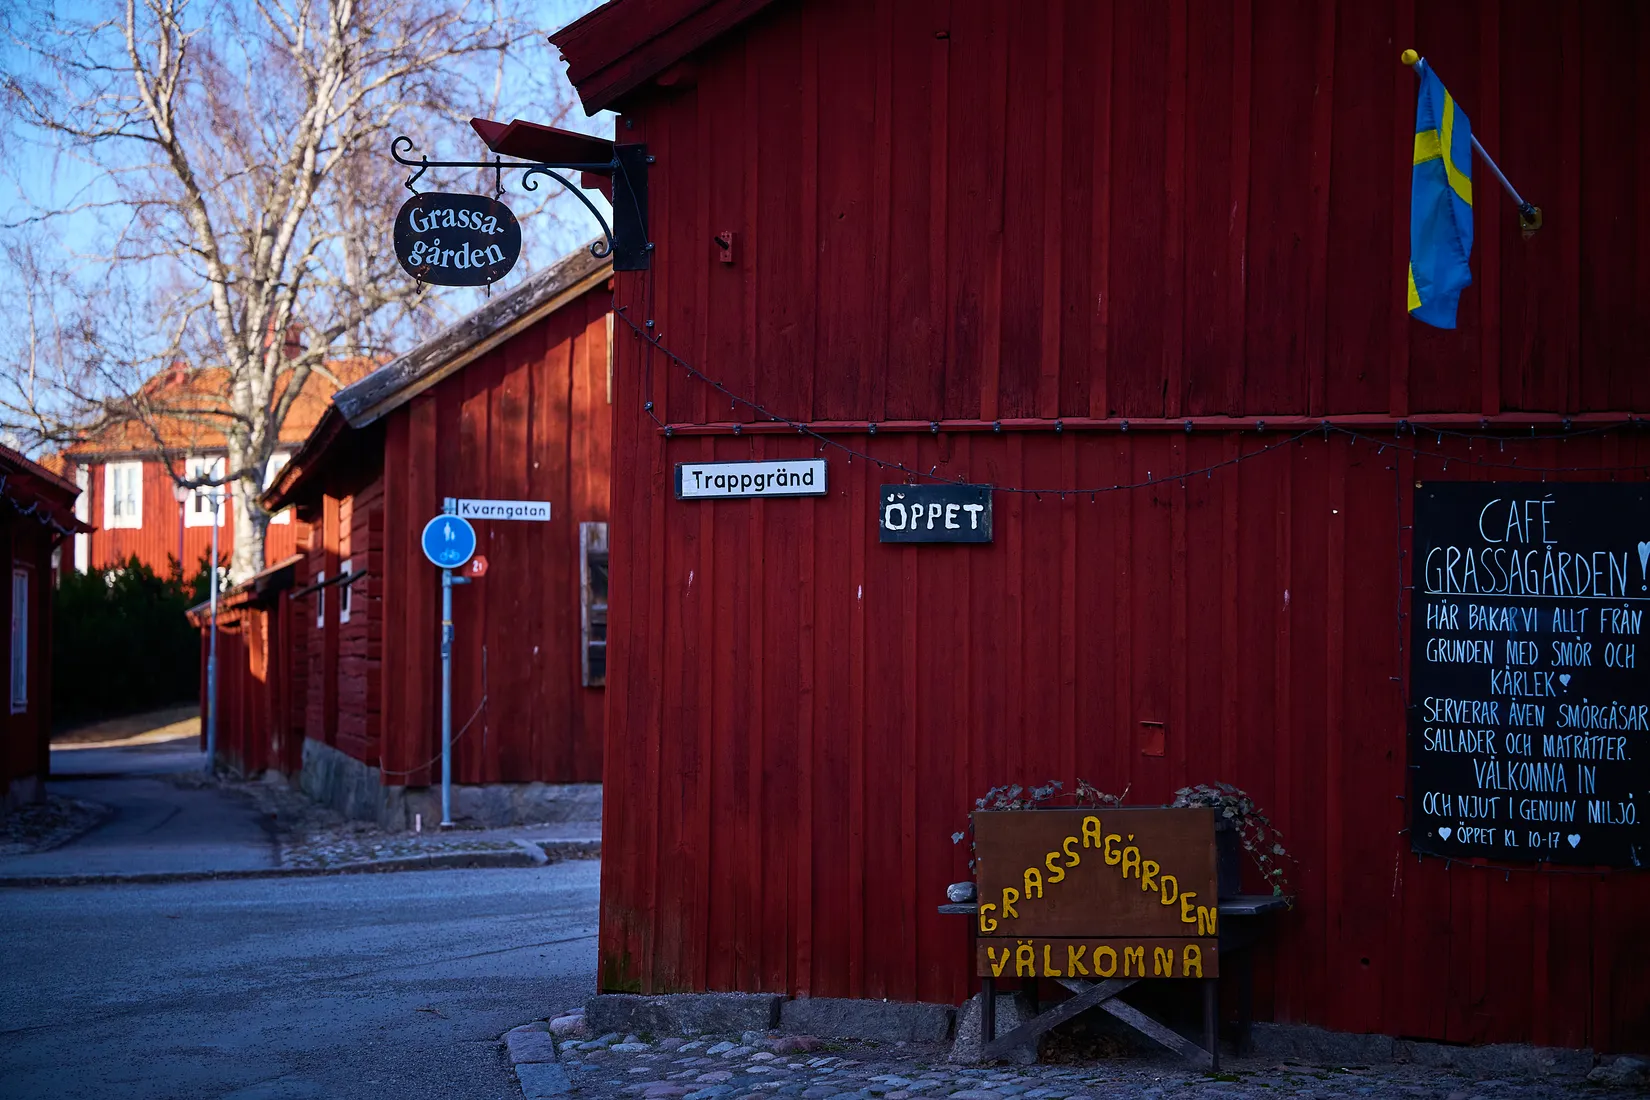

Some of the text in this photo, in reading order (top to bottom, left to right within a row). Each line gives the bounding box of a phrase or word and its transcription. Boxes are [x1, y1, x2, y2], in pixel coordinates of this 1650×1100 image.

[409, 207, 504, 235] Grassa-
[407, 238, 506, 269] gården
[692, 467, 814, 492] Trappgränd
[462, 503, 546, 519] Kvarngatan
[884, 492, 984, 530] ÖPPET
[1479, 493, 1558, 543] CAFÉ
[1425, 544, 1628, 596] GRASSAGÅRDEN
[1427, 599, 1643, 634] HÄR BAKAR VI ALLT FRÅN
[1426, 636, 1635, 668] GRUNDEN MED SMÖR OCH
[1423, 696, 1649, 731] SERVERAR ÄVEN SMÖRGÅSAR
[1423, 728, 1632, 761] SALLADER OCH MATRÄTTER.
[1473, 755, 1596, 794] VÄLKOMNA IN
[1423, 792, 1640, 824] OCH NJUT I GENUIN MILJÖ.
[1456, 821, 1560, 848] ÖPPET KL 10-17
[979, 815, 1217, 936] GRASSAGÅRDEN
[987, 939, 1203, 978] VÄLKOMNA
